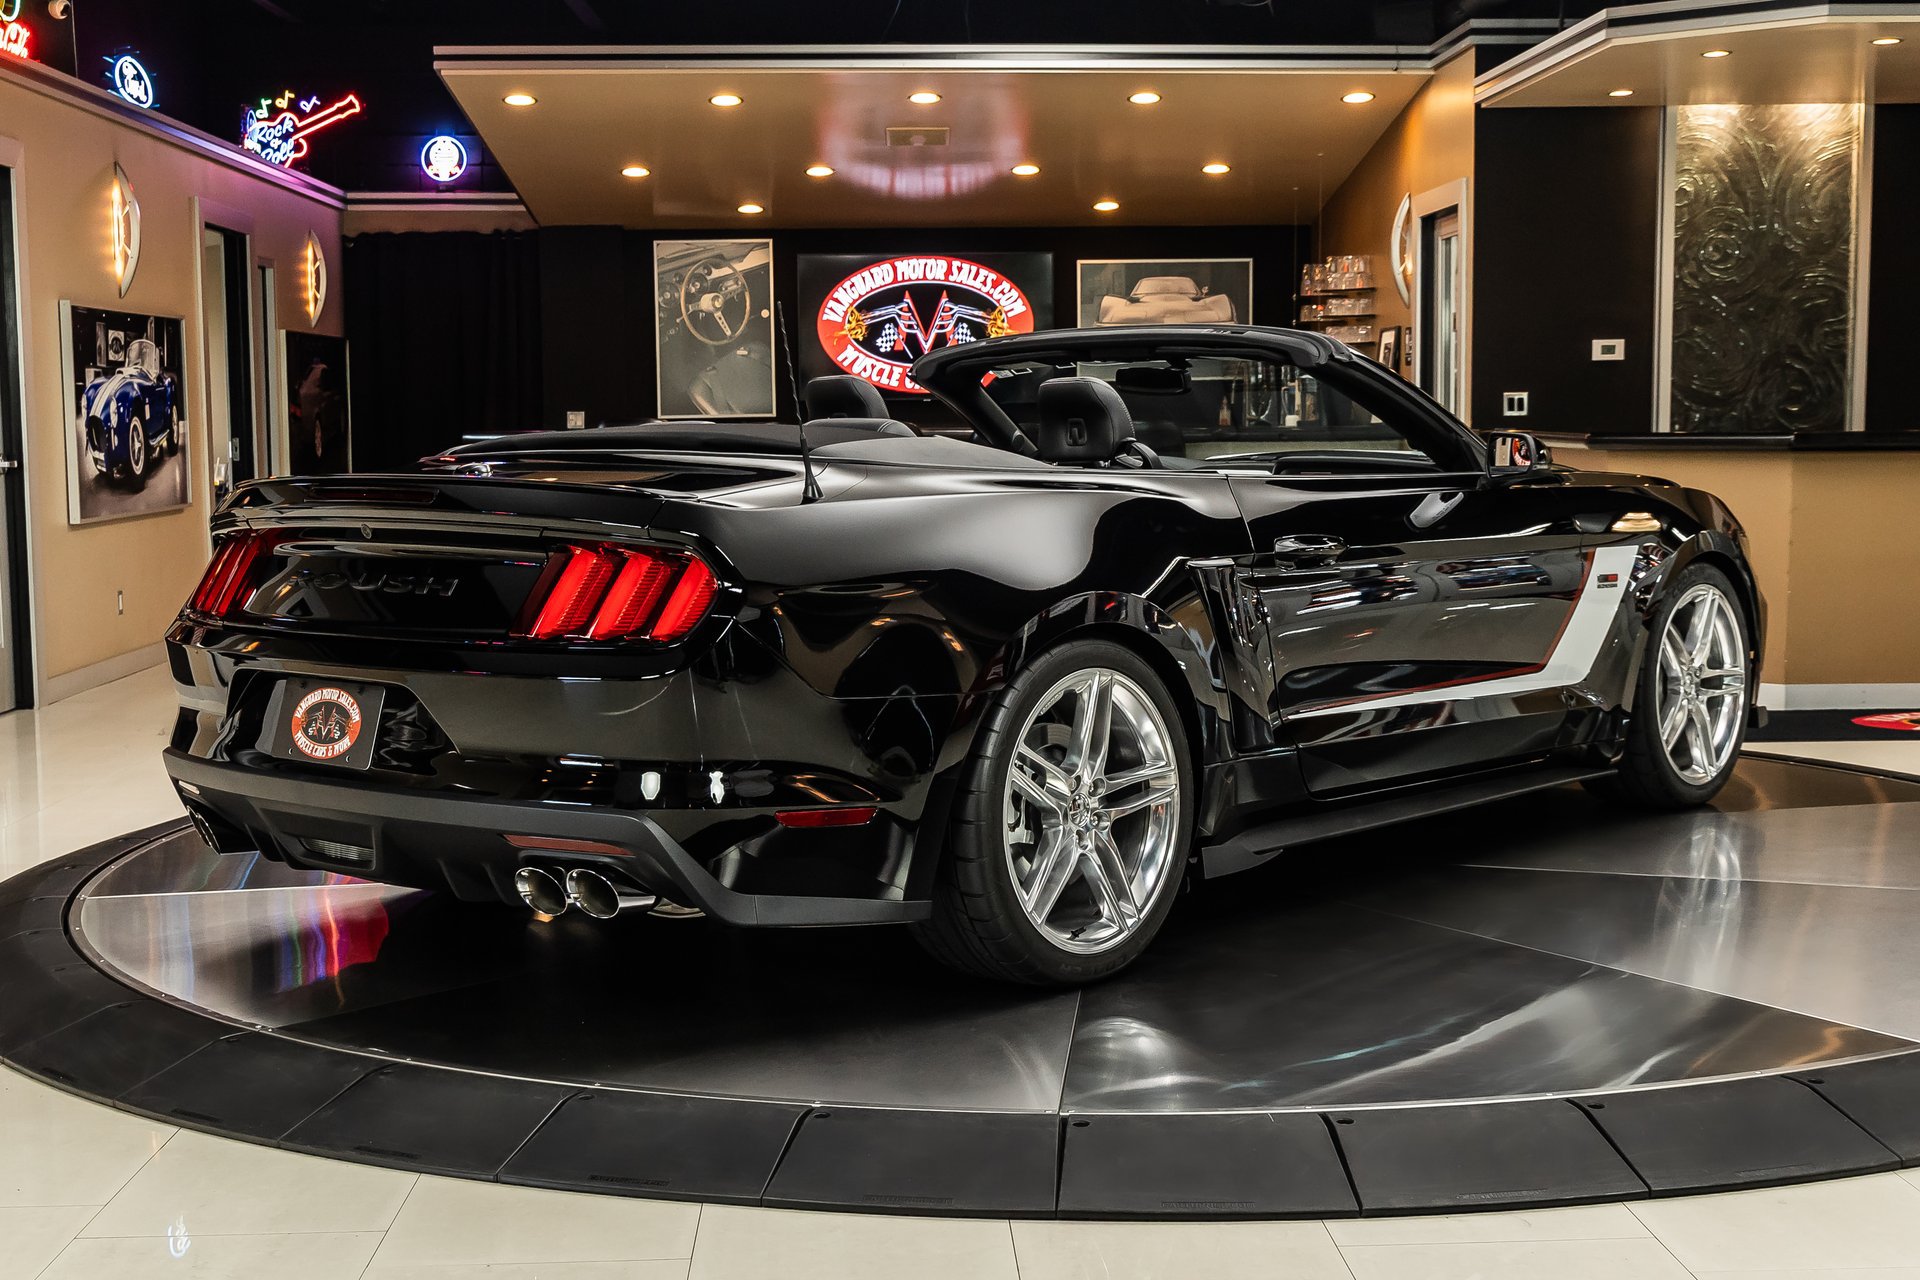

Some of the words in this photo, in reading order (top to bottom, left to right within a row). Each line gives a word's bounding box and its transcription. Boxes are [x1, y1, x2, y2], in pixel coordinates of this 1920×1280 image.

[254, 116, 294, 143] Rock
[822, 263, 895, 323] VANGUARD
[893, 258, 948, 281] MOTOR
[948, 260, 1027, 318] SALES.COM
[836, 344, 903, 387] MUSCLE
[294, 690, 322, 719] VANGUARD
[322, 688, 340, 700] MOTOR
[294, 730, 313, 754] MUSCLE
[312, 745, 327, 757] CARS
[333, 736, 351, 756] MORE
